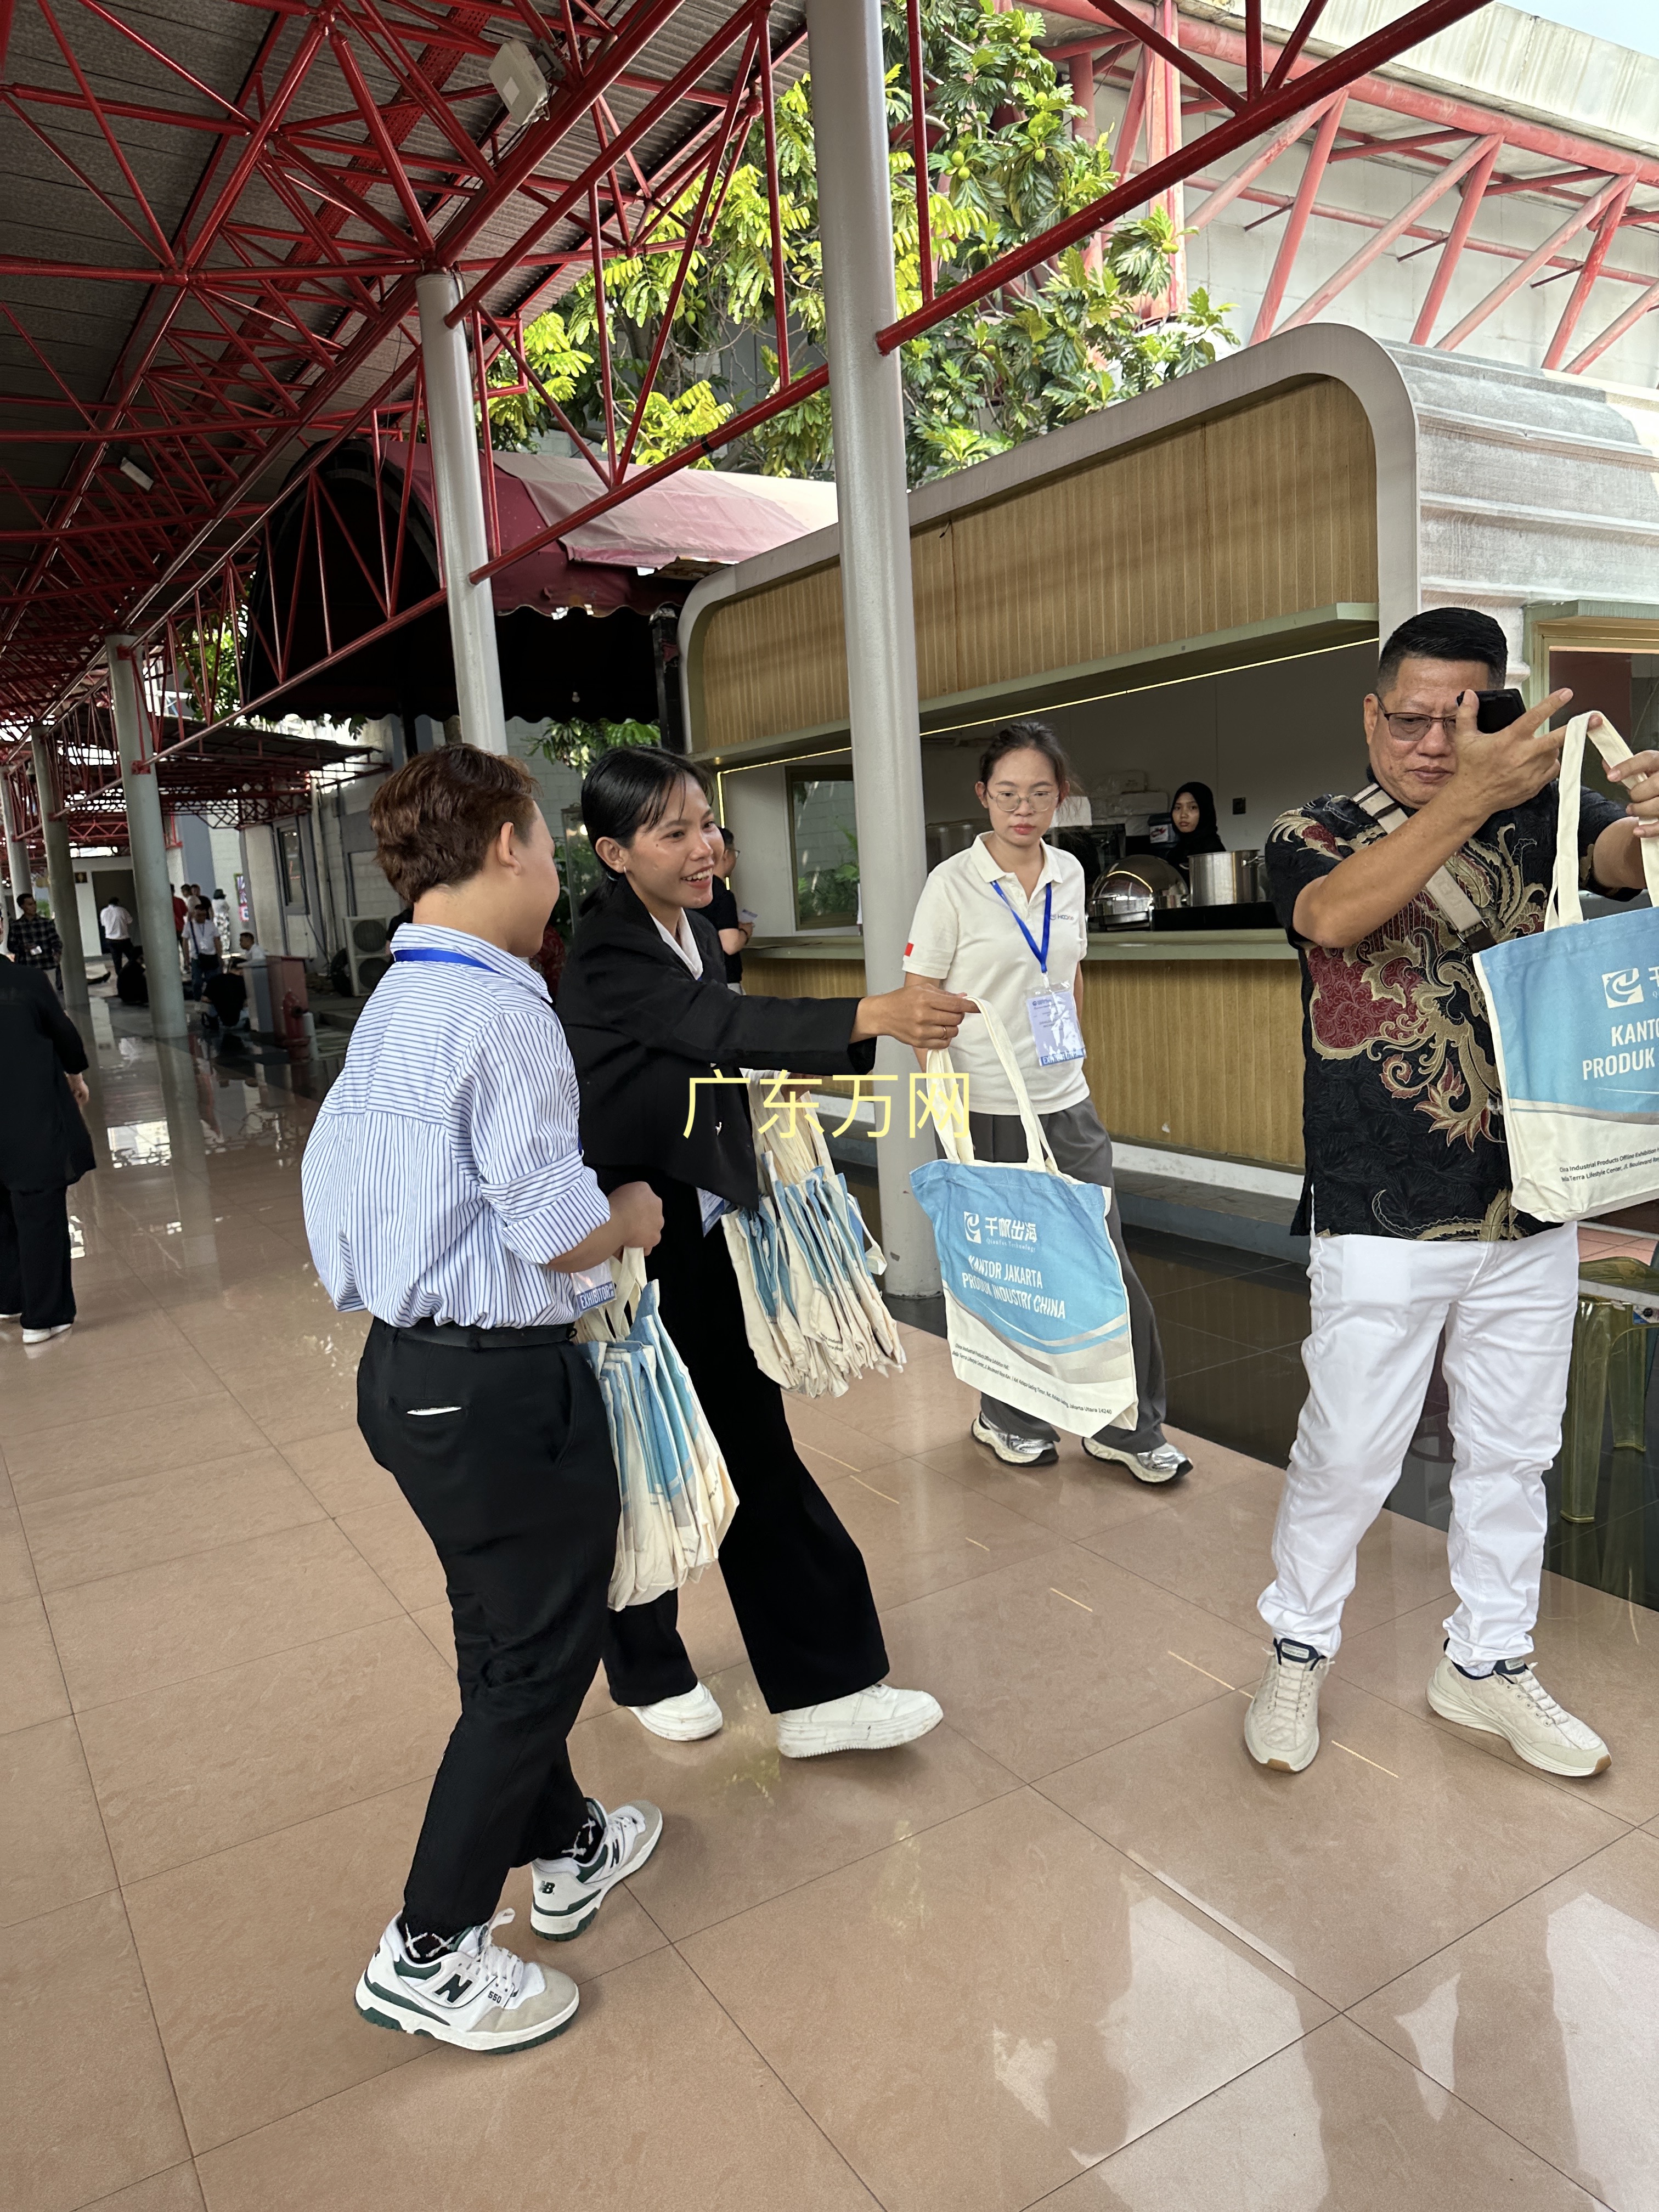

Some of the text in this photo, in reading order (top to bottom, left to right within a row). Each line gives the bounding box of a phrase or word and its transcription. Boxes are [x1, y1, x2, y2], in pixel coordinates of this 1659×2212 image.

[1583, 1047, 1655, 1080] PRODUK
[1570, 1161, 1596, 1171] Industrial
[1596, 1157, 1619, 1166] Products
[1619, 1153, 1634, 1161] Offline
[1635, 1148, 1656, 1157] Exhibition
[1587, 1170, 1606, 1179] Lifestyle
[1629, 1158, 1652, 1168] Boulevard
[968, 1255, 1043, 1289] KANTOR JAKARTA
[580, 1285, 611, 1309] EXHIBITOR
[962, 1272, 1066, 1319] PRODUK INDUSTRI CHINA
[434, 1973, 473, 2003] N
[488, 1990, 502, 2004] 550
